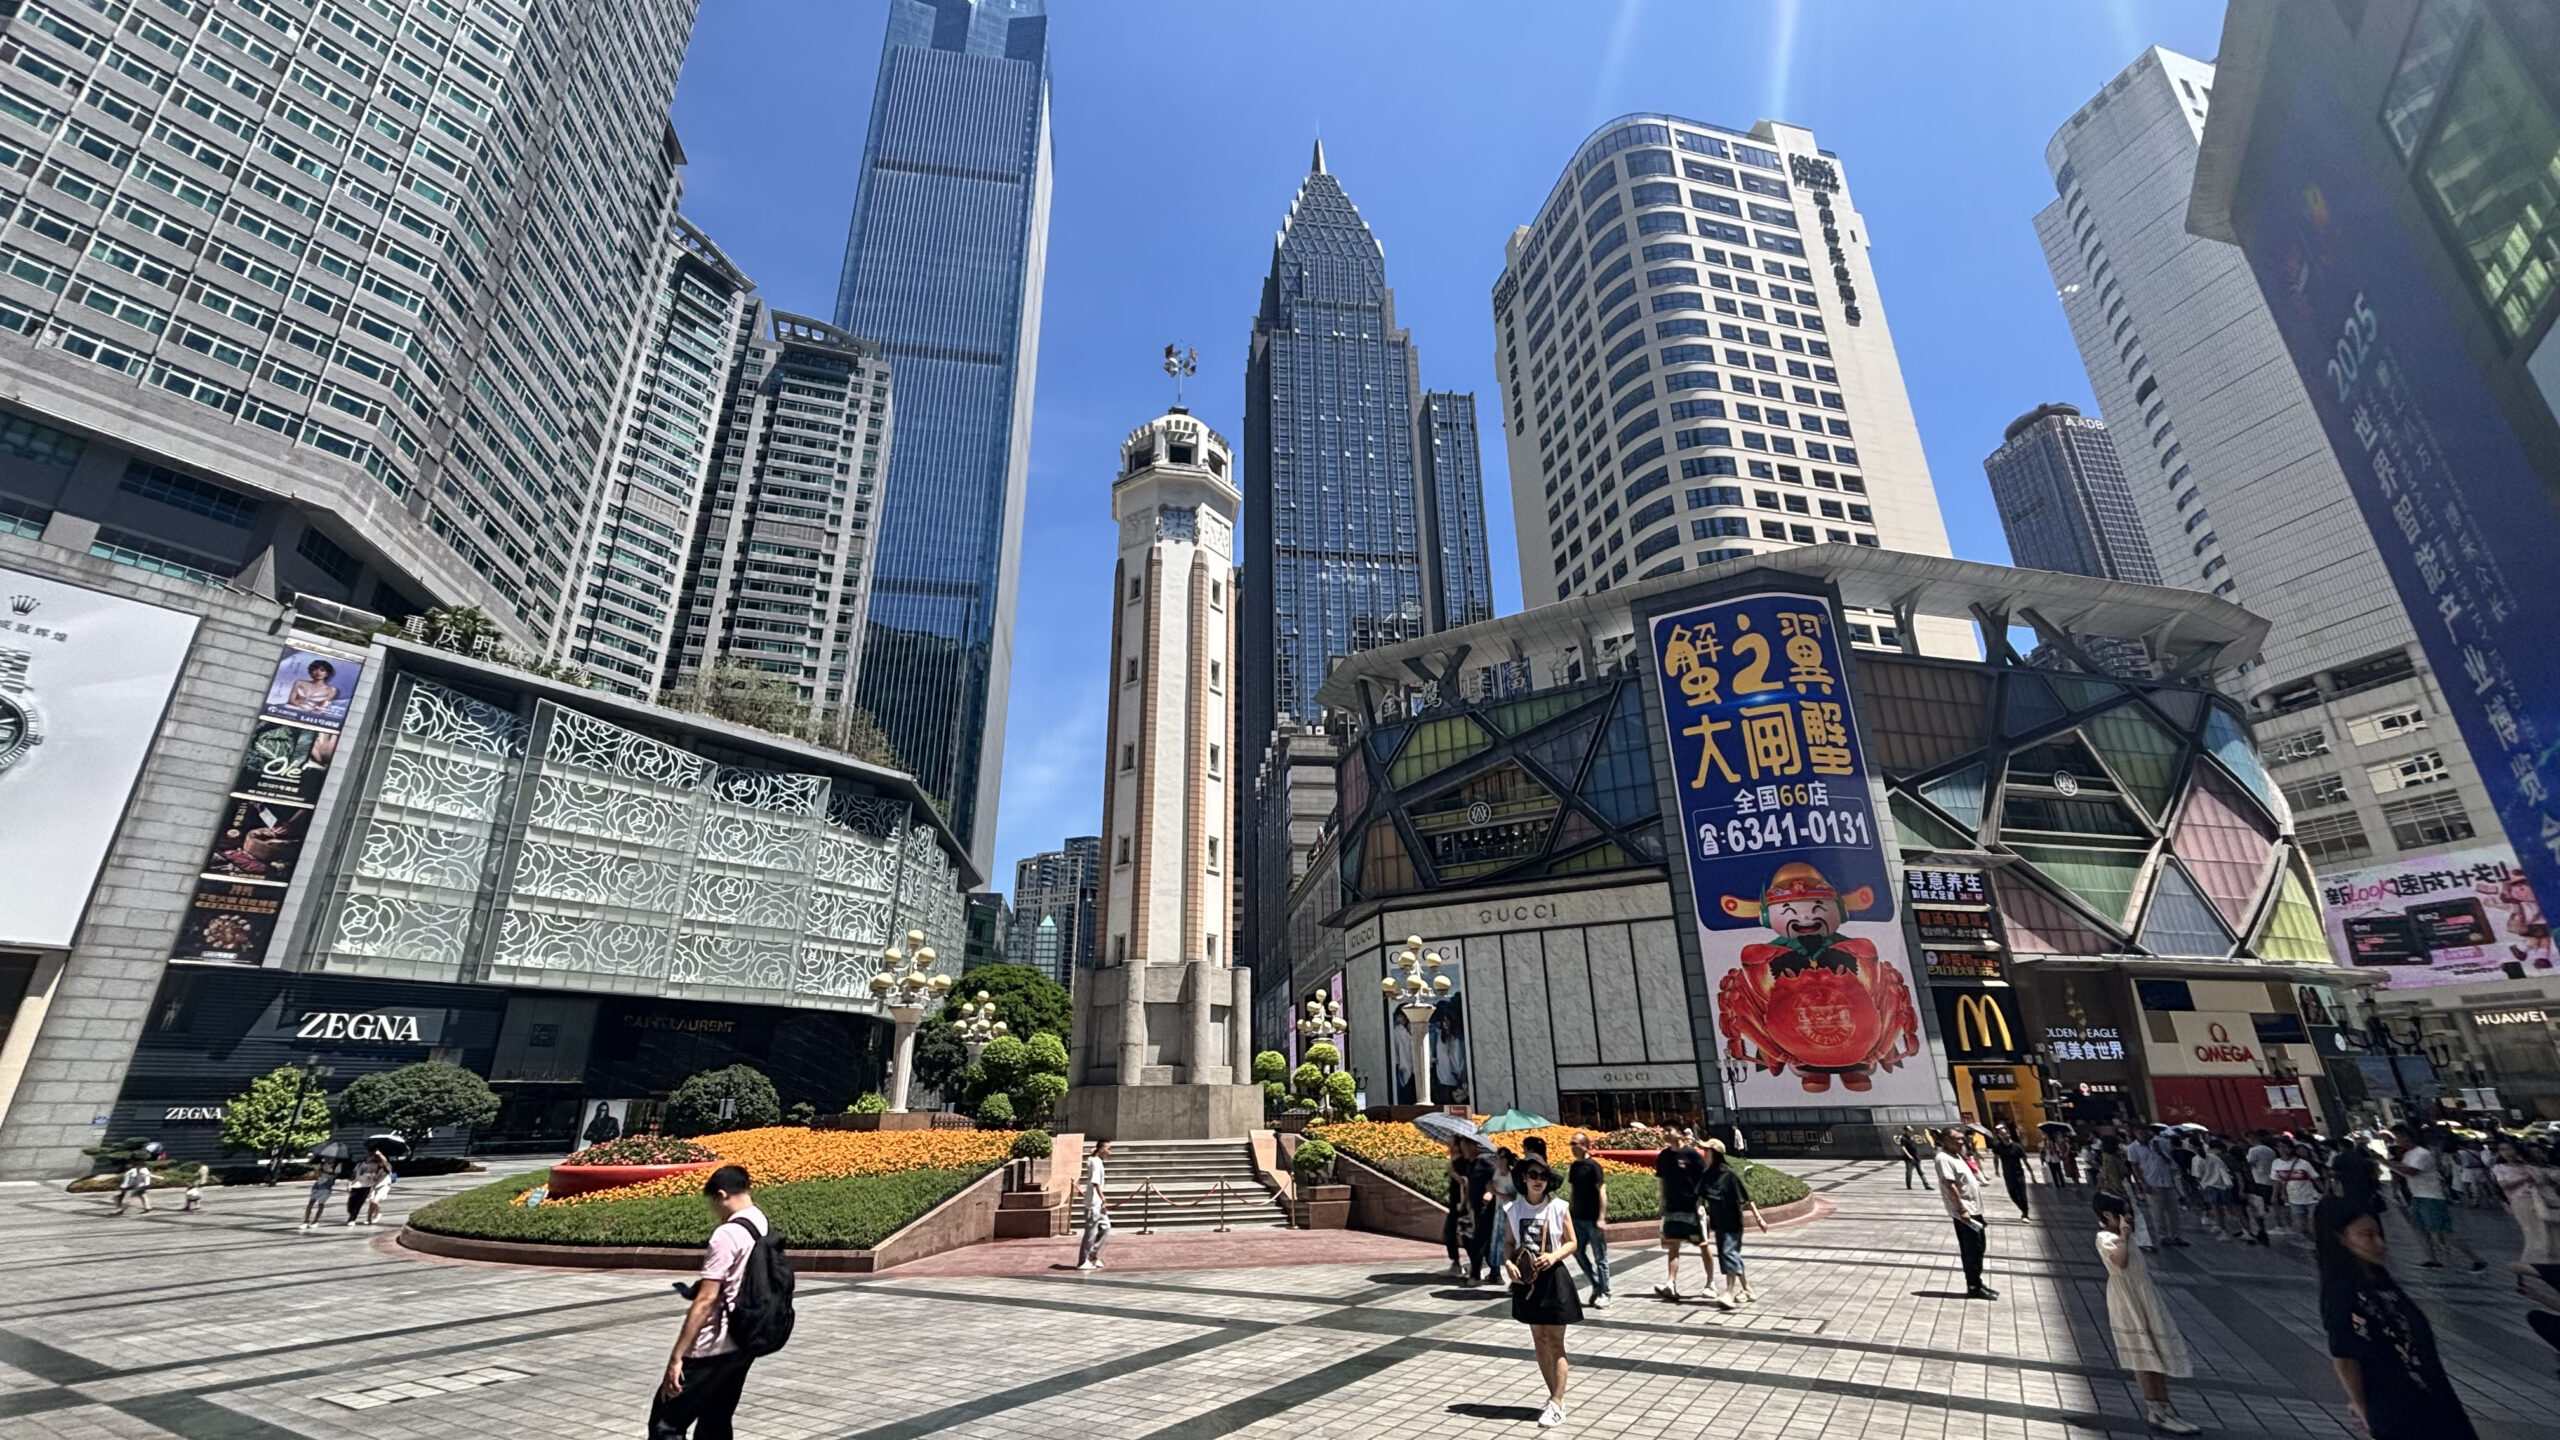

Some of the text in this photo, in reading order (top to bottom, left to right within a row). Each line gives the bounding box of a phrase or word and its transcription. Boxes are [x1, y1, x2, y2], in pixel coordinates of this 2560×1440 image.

[2328, 290, 2377, 403] 2025
[1733, 780, 1830, 815] 全国66店
[1908, 870, 1984, 892] 寻意养生
[1479, 903, 1557, 925] GUCCI
[1351, 926, 1376, 948] GUCCI
[296, 1012, 421, 1041] ZEGNA
[670, 1018, 736, 1033] LAURENT
[2474, 1010, 2549, 1026] HUAWEI
[2086, 1028, 2119, 1038] EAGLE
[2048, 1040, 2125, 1060] 鹰美食世界
[2195, 1046, 2255, 1062] OMEGA
[1603, 1072, 1650, 1082] GUCCI
[164, 1106, 222, 1120] ZEGNA
